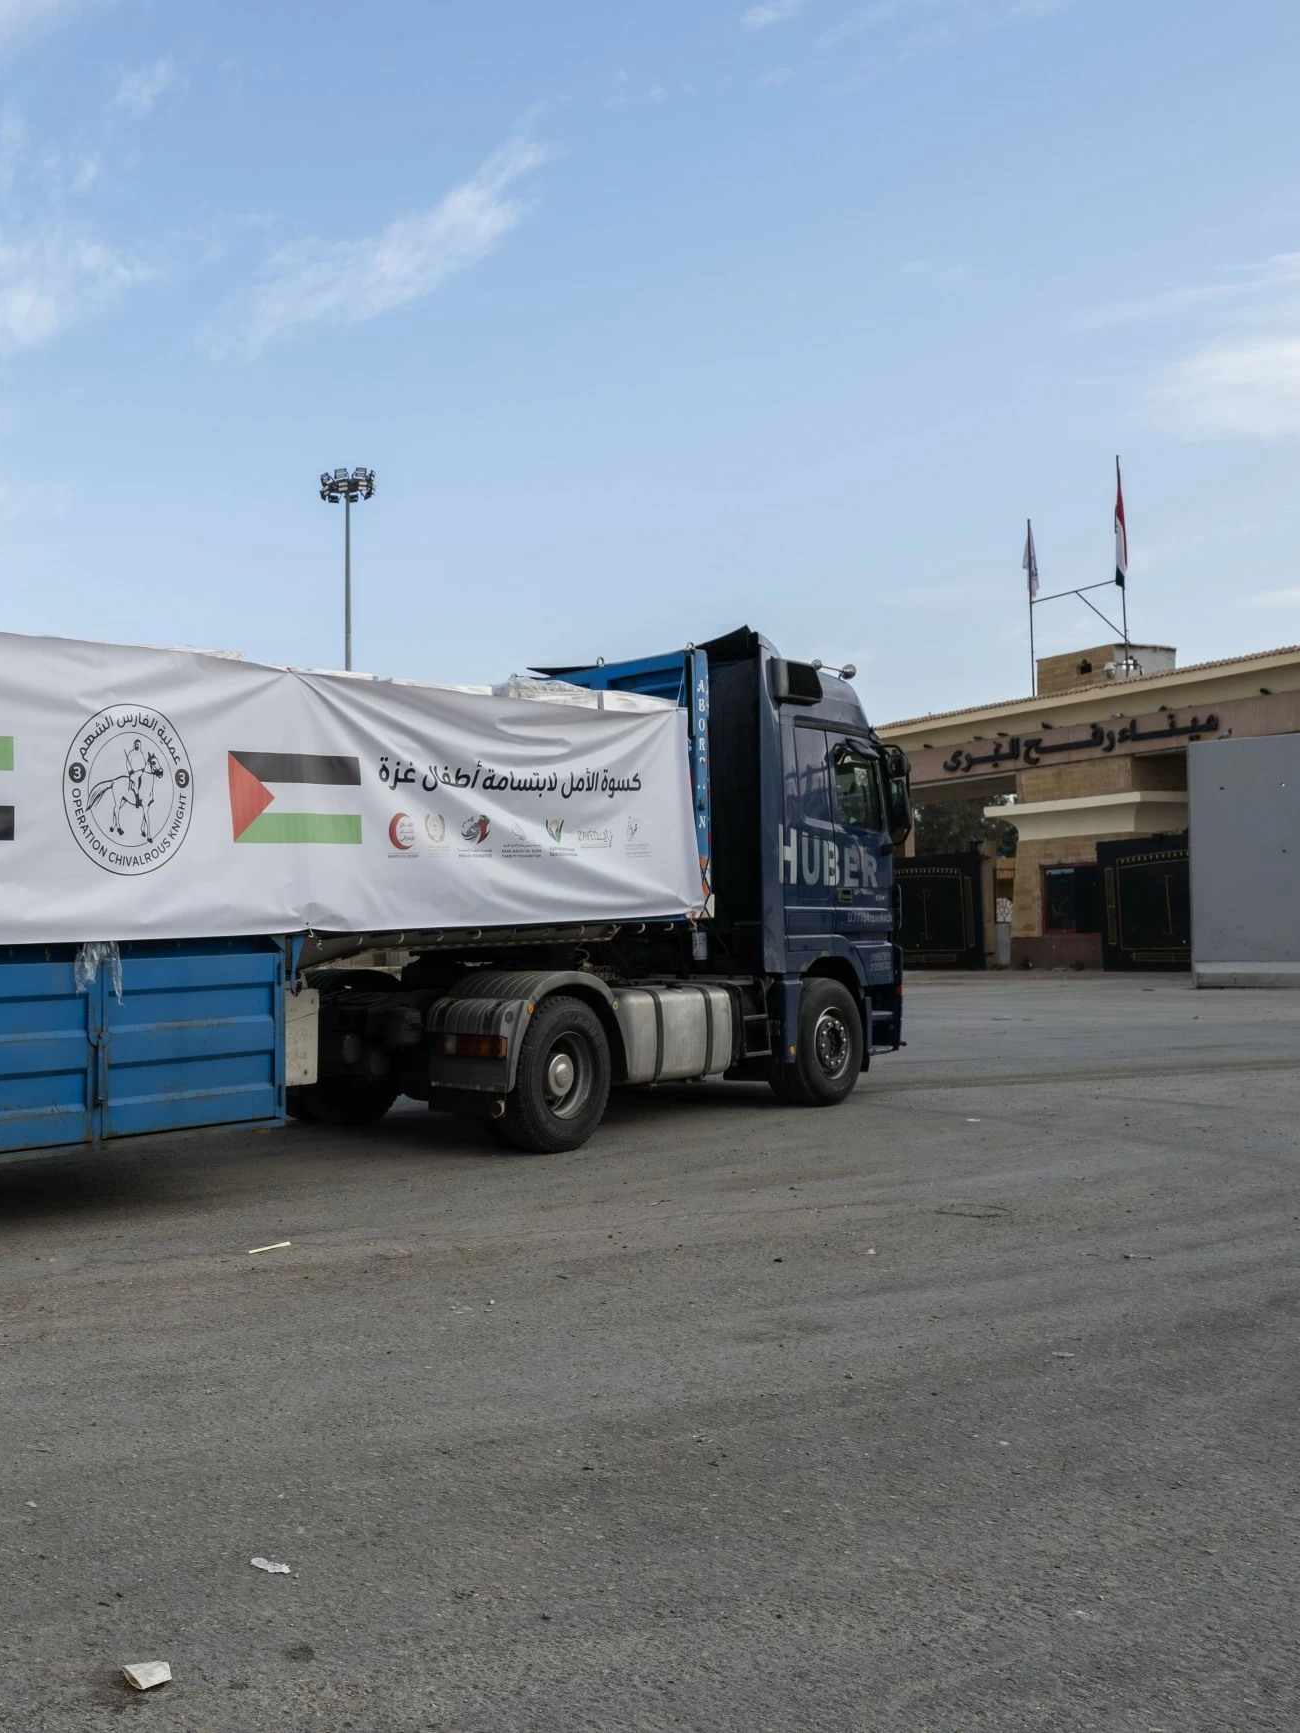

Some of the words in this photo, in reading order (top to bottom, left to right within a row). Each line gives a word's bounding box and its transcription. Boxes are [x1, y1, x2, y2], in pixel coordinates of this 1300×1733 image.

[117, 712, 158, 731] الفارس
[1117, 713, 1219, 742] ميناء
[79, 715, 114, 763] الشهم
[157, 725, 181, 765] عملية
[1023, 723, 1116, 765] رفح
[379, 756, 416, 790] غزة
[422, 759, 482, 792] أطفال
[482, 769, 558, 798] لابتسامة
[561, 768, 599, 799] الأمل
[601, 769, 642, 799] كسوة
[72, 788, 108, 857] OPERATION
[108, 837, 171, 867] CHIVALROUS
[167, 792, 187, 840] KNIGHT
[778, 823, 878, 888] HUBER
